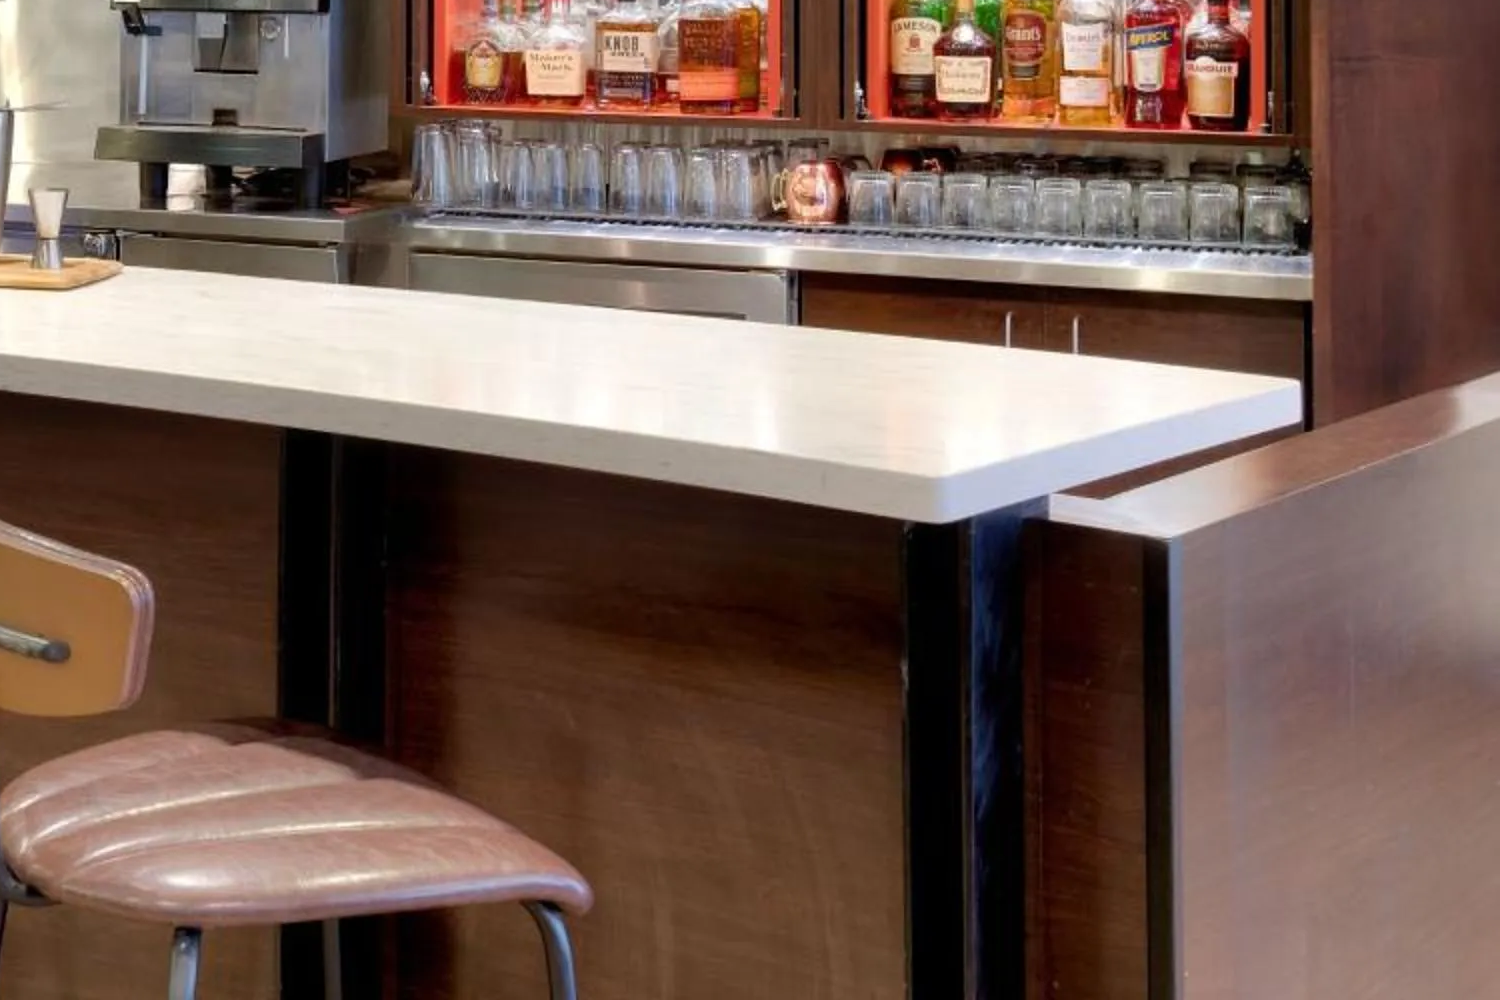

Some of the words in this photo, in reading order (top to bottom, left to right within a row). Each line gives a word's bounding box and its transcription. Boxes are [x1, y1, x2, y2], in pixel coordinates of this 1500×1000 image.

[893, 21, 937, 33] JAMESON
[605, 36, 639, 51] KNOB
[529, 52, 574, 62] Maker's
